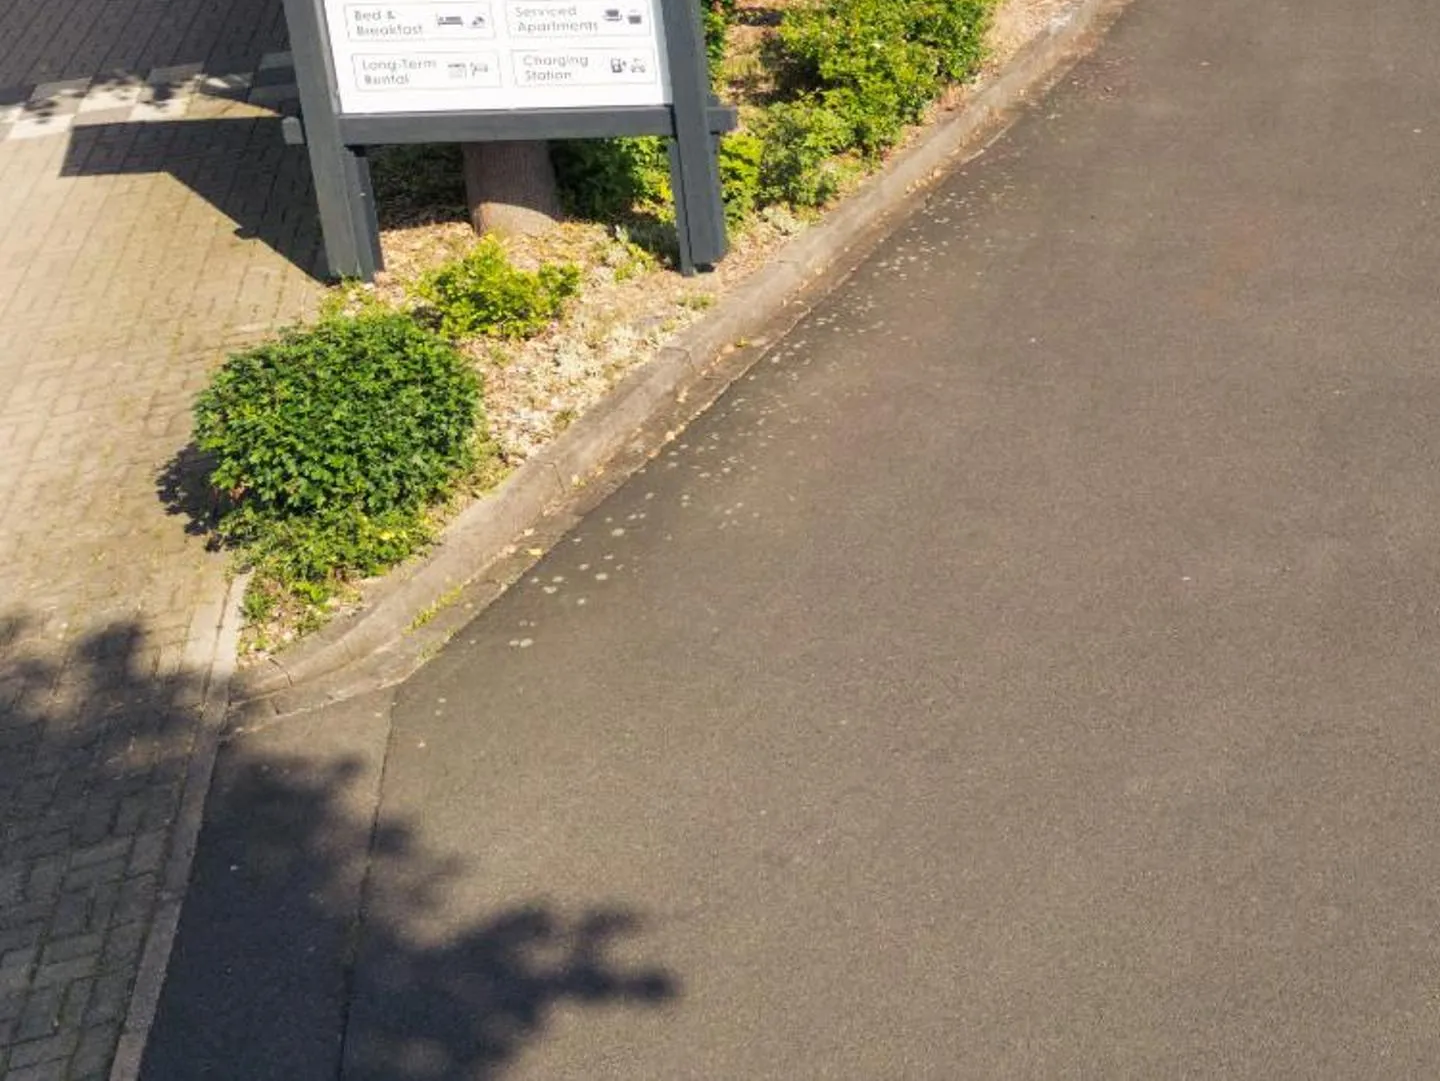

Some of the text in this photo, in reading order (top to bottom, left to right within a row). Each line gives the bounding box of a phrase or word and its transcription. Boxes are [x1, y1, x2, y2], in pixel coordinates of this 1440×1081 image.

[354, 9, 396, 22] Bed &
[515, 6, 577, 18] Serviced
[356, 22, 424, 37] Breakfast
[517, 20, 599, 35] Apartments
[362, 57, 437, 73] Long-Term
[523, 54, 589, 69] Charging
[364, 72, 411, 85] Rental
[525, 68, 572, 82] Station
